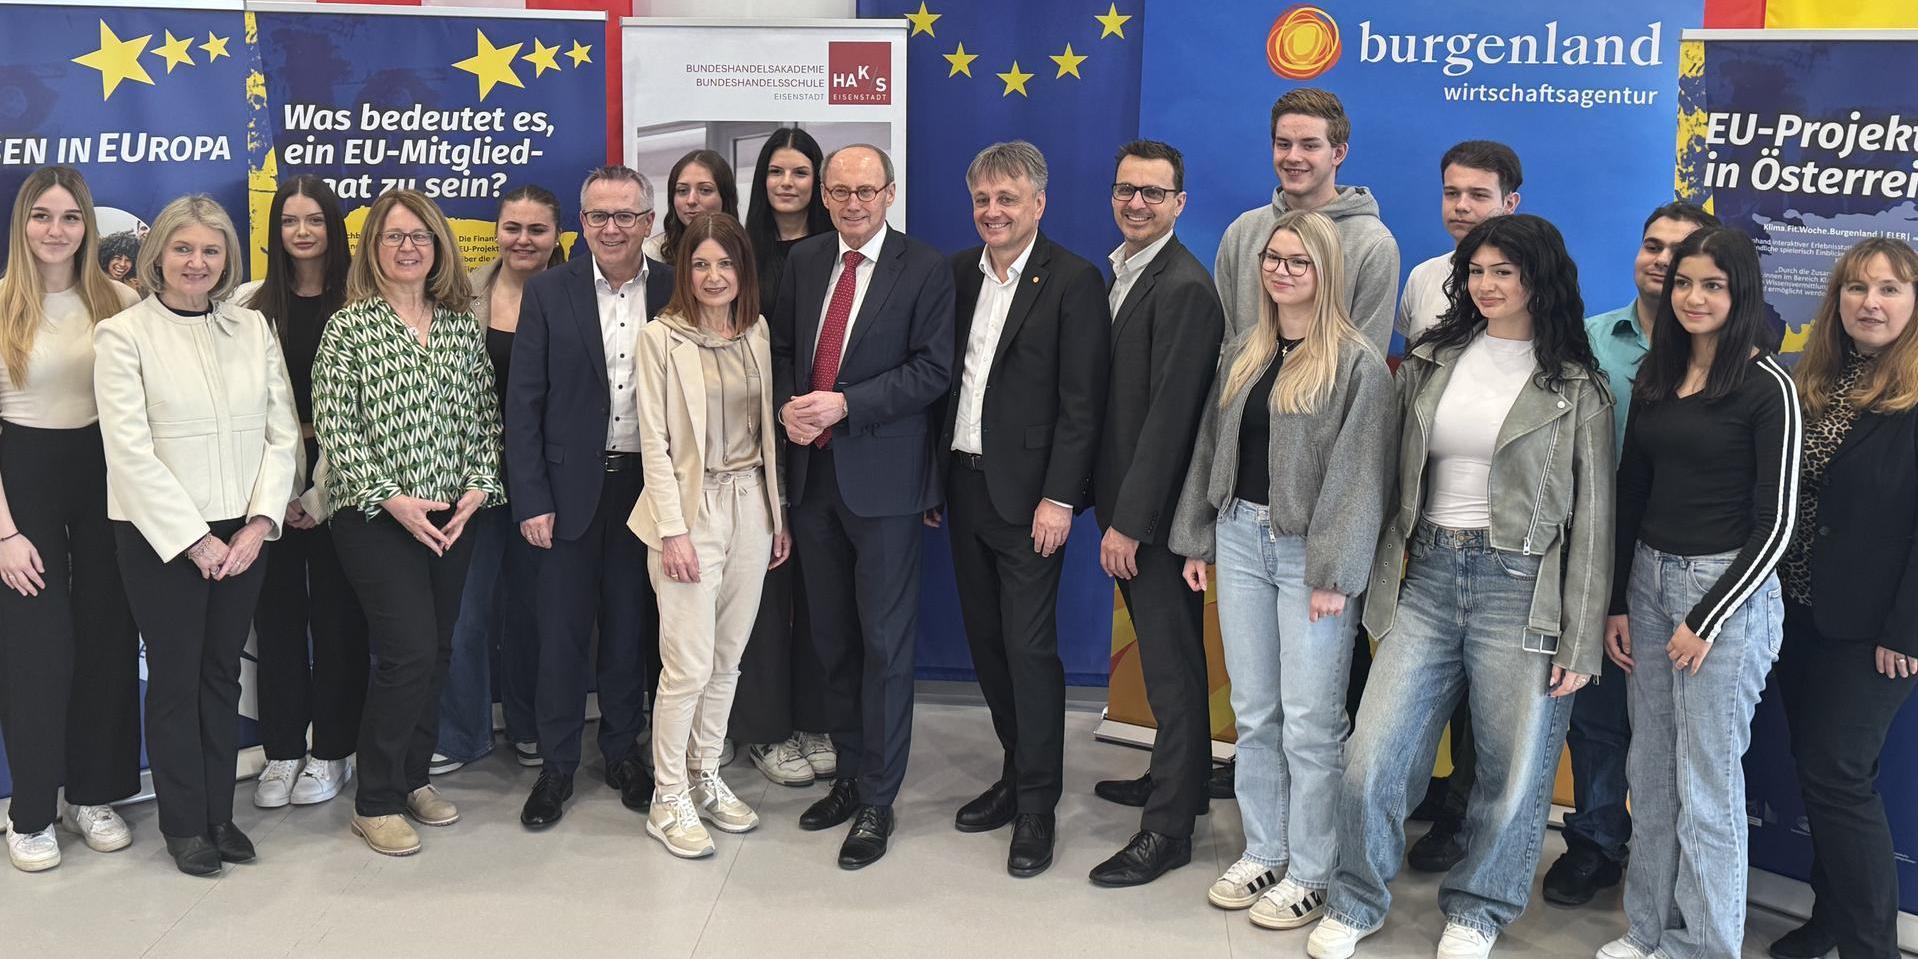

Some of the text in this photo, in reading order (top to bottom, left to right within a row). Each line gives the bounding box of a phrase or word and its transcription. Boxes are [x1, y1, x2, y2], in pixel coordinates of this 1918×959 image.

[1359, 20, 1663, 76] burgenland
[686, 64, 825, 74] BUNDESHANDELSAKADEMIE
[696, 78, 825, 88] BUNDESHANDELSSCHULE
[774, 93, 825, 101] EISENSTADT
[833, 93, 887, 101] EISENSTADT
[1444, 83, 1658, 108] wirtschaftsagentur
[284, 103, 555, 138] Was bedeutet es,
[0, 132, 232, 165] EN IN EUROPA
[284, 135, 544, 172] ein EU-Mitglied-
[424, 169, 508, 198] sein?
[1704, 147, 1918, 199] in Österrei
